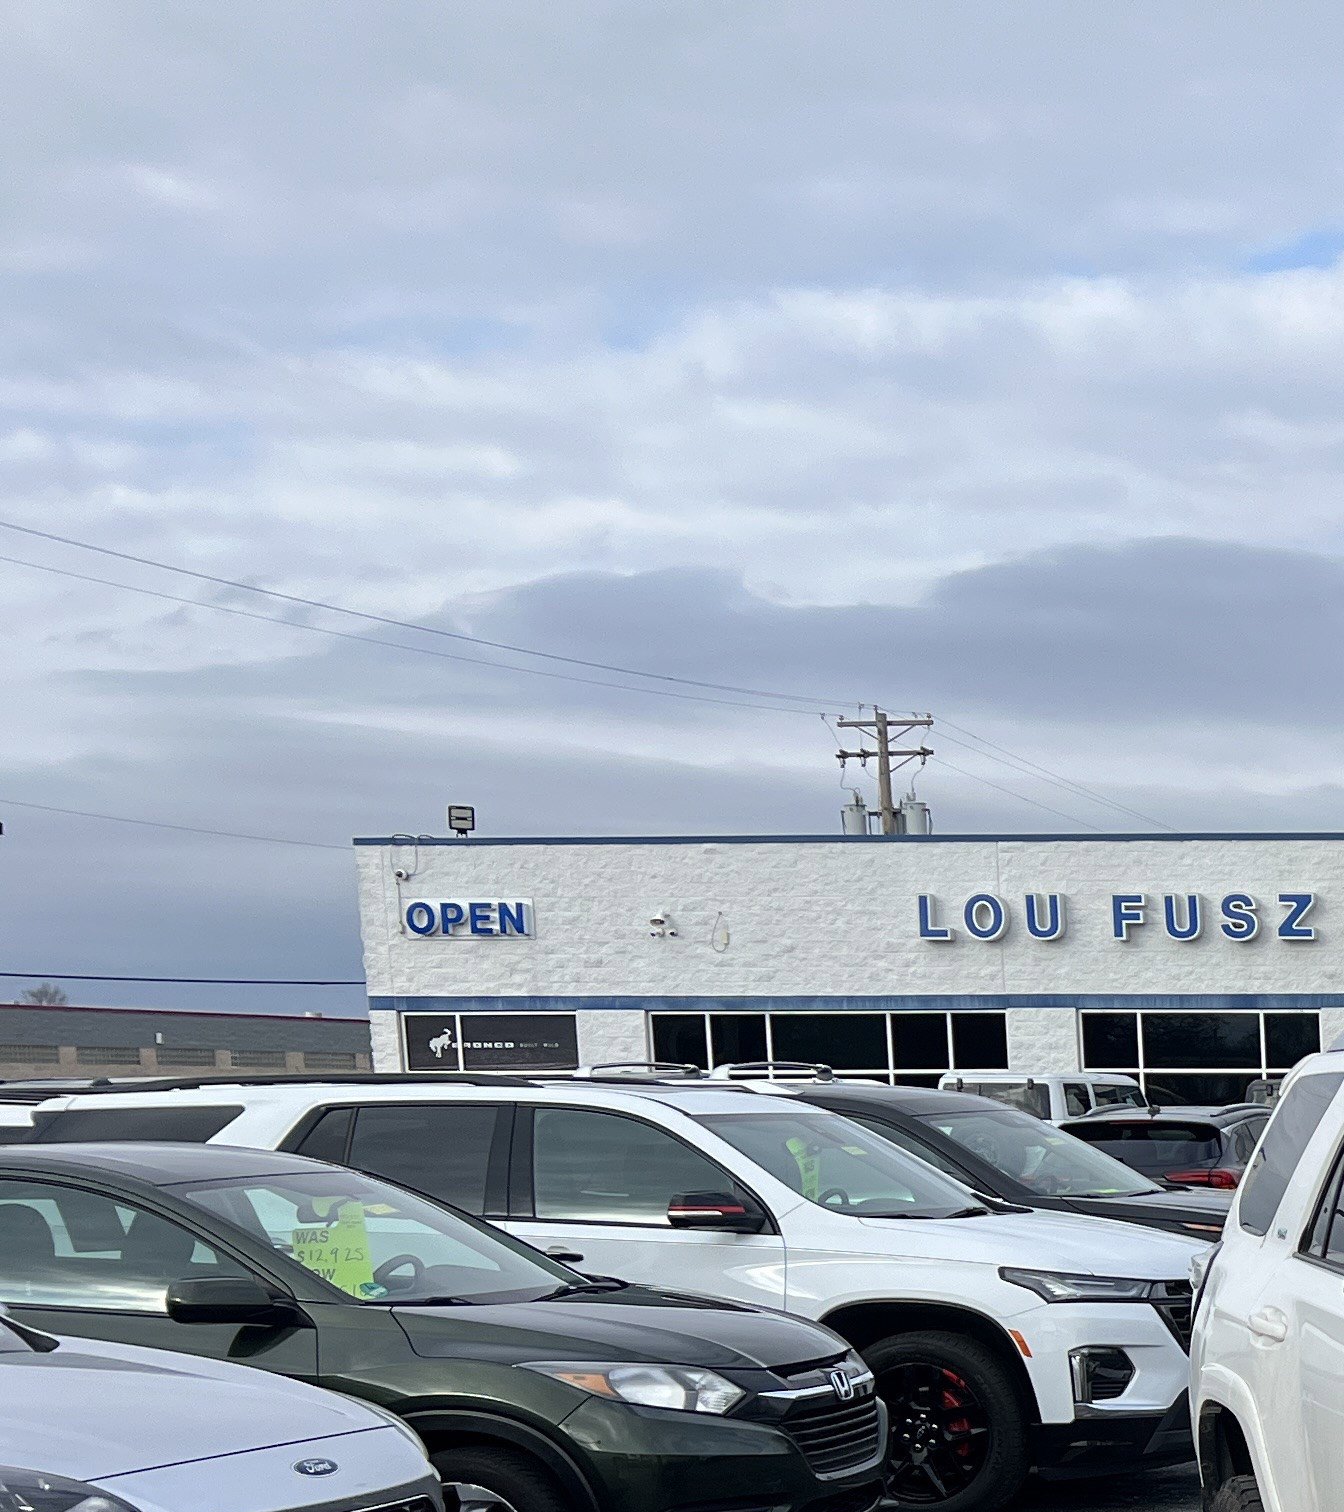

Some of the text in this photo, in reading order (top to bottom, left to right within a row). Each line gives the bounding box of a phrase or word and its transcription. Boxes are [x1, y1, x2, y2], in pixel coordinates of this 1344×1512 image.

[405, 901, 530, 937] OPEN
[918, 893, 1318, 940] LOU FUSZ
[295, 1230, 330, 1244] WAS
[305, 1459, 332, 1473] Ford
